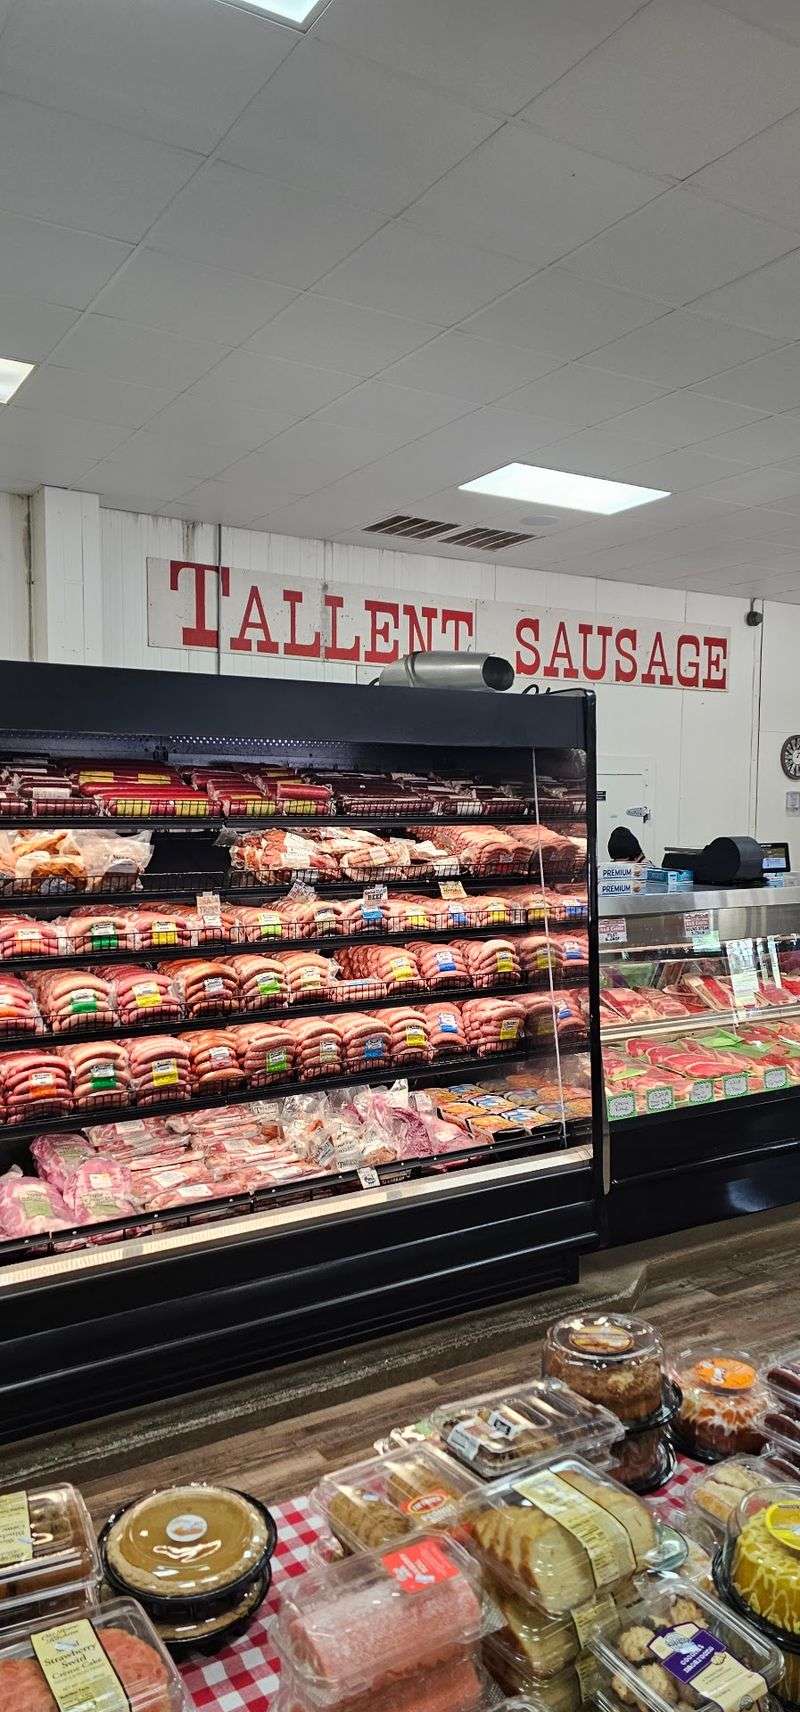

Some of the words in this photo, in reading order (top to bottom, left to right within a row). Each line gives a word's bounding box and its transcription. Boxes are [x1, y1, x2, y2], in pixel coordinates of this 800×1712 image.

[515, 617, 728, 690] SAUSAGE
[602, 868, 632, 877] PREMIUM
[602, 884, 631, 893] PREMIUM
[44, 1645, 96, 1666] Strawberry
[61, 1654, 87, 1669] Swirl
